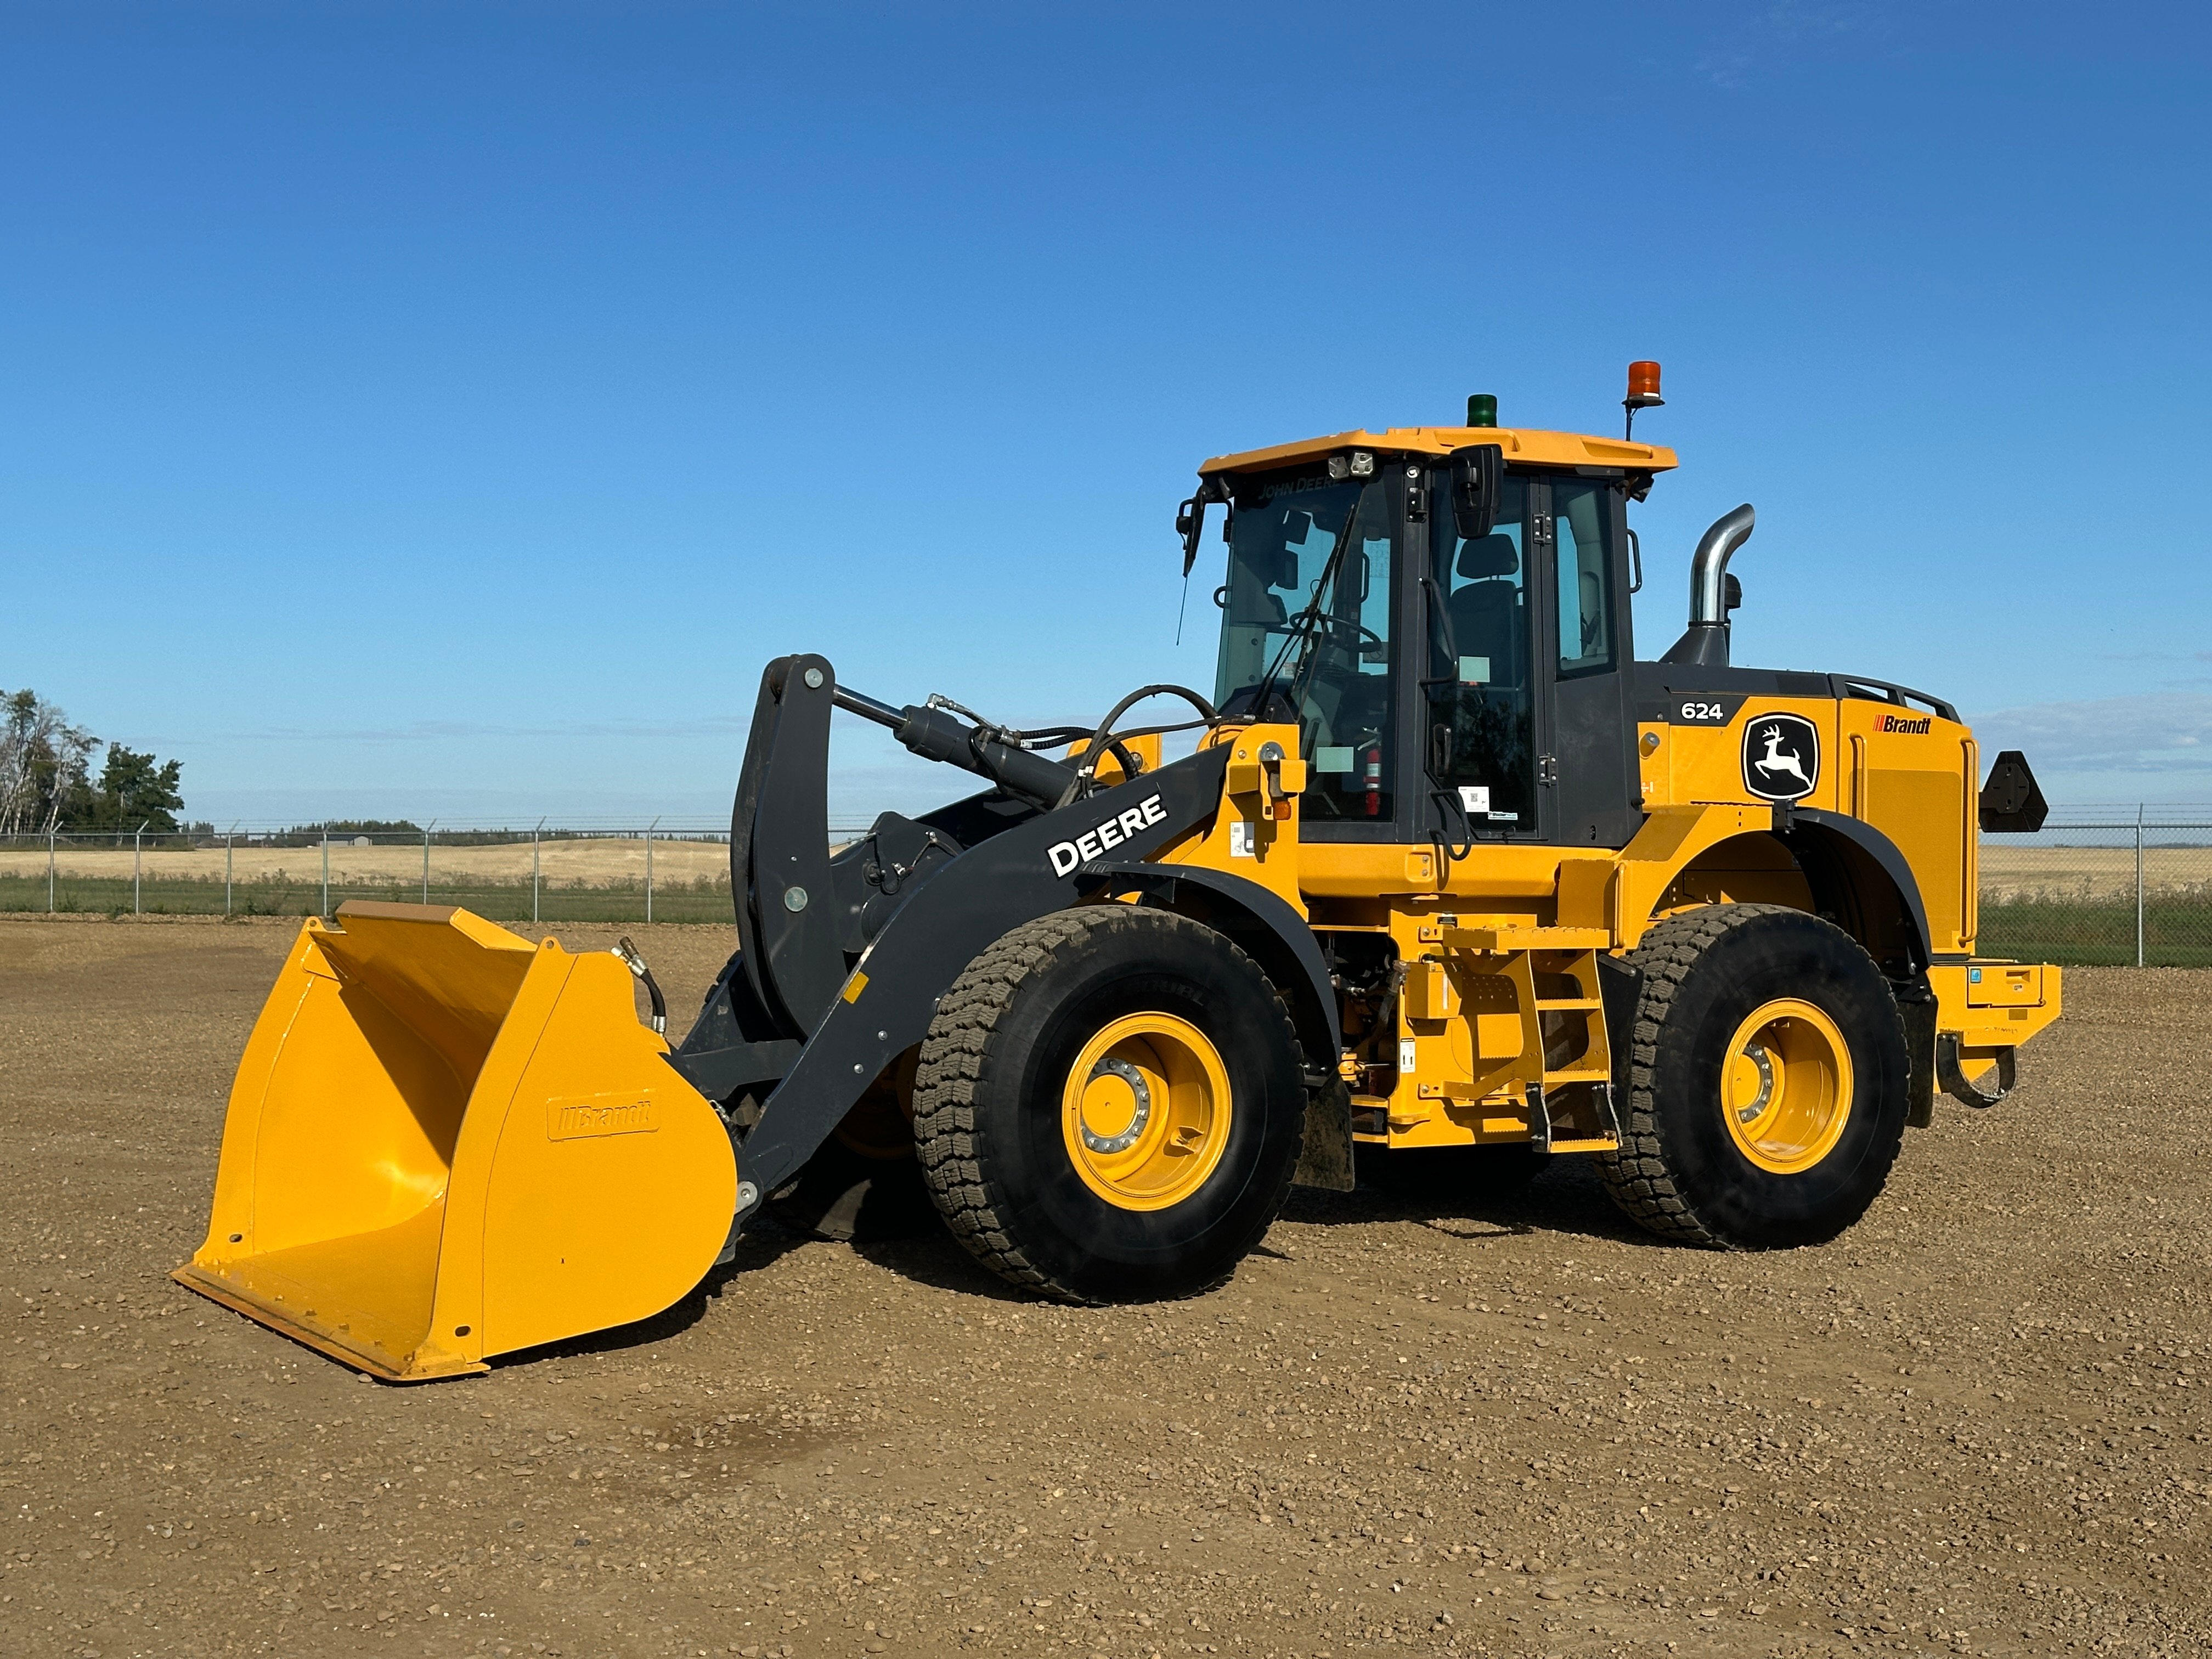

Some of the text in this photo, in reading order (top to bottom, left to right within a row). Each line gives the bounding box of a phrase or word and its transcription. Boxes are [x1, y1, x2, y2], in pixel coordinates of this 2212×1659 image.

[1258, 481, 1294, 500] JOHN
[1681, 702, 1723, 720] 624
[1883, 715, 1931, 735] Brandt
[1047, 794, 1167, 878] DEERE
[578, 1101, 651, 1128] Brandt
